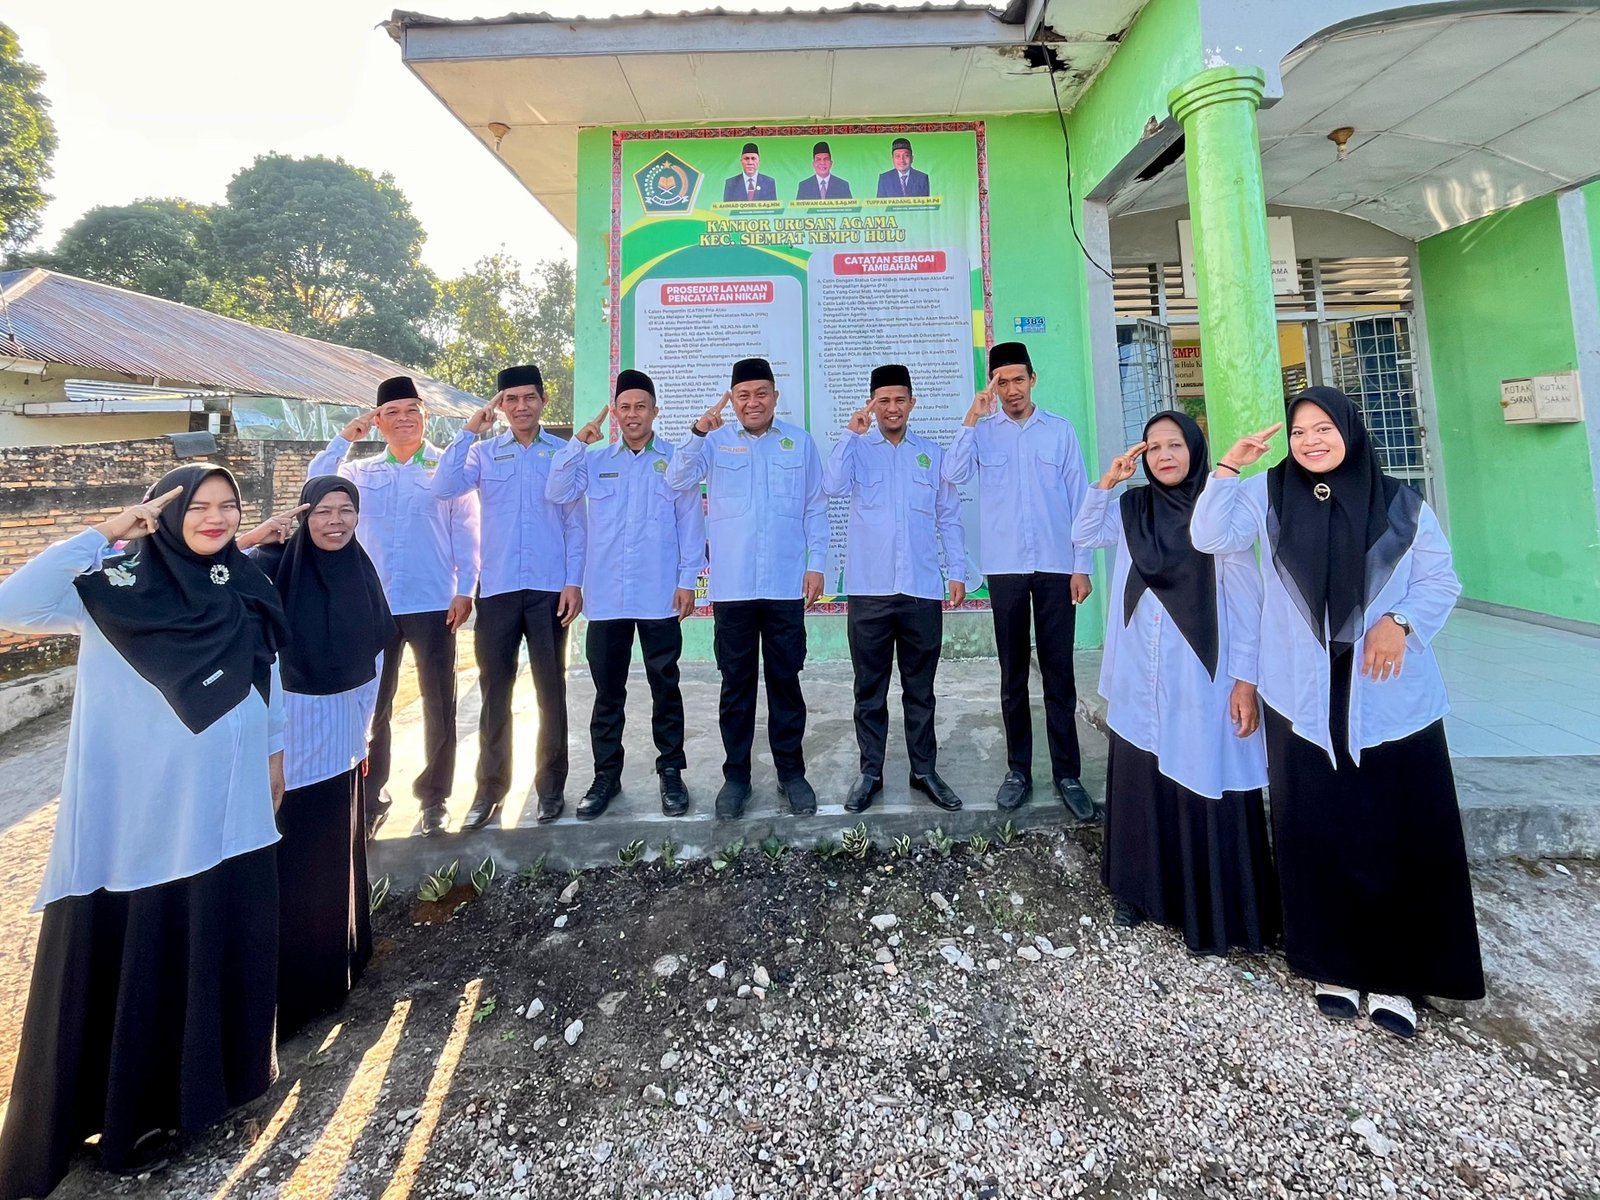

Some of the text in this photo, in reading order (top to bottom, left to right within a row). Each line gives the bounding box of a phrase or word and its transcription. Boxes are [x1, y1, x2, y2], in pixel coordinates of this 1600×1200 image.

[706, 215, 898, 233] KANTOR URUSAN AGAMA
[699, 228, 906, 247] KEC. SIEMPAT NEMPU HULU
[844, 254, 935, 264] CATATAN SEBAGAI
[862, 263, 918, 272] TAMBAHAN
[667, 284, 768, 294] PROSEDUR LAYANAN
[668, 292, 766, 303] PENCATATAN NIKAH
[1504, 385, 1532, 394] KOTAK
[1510, 396, 1533, 404] SARAN
